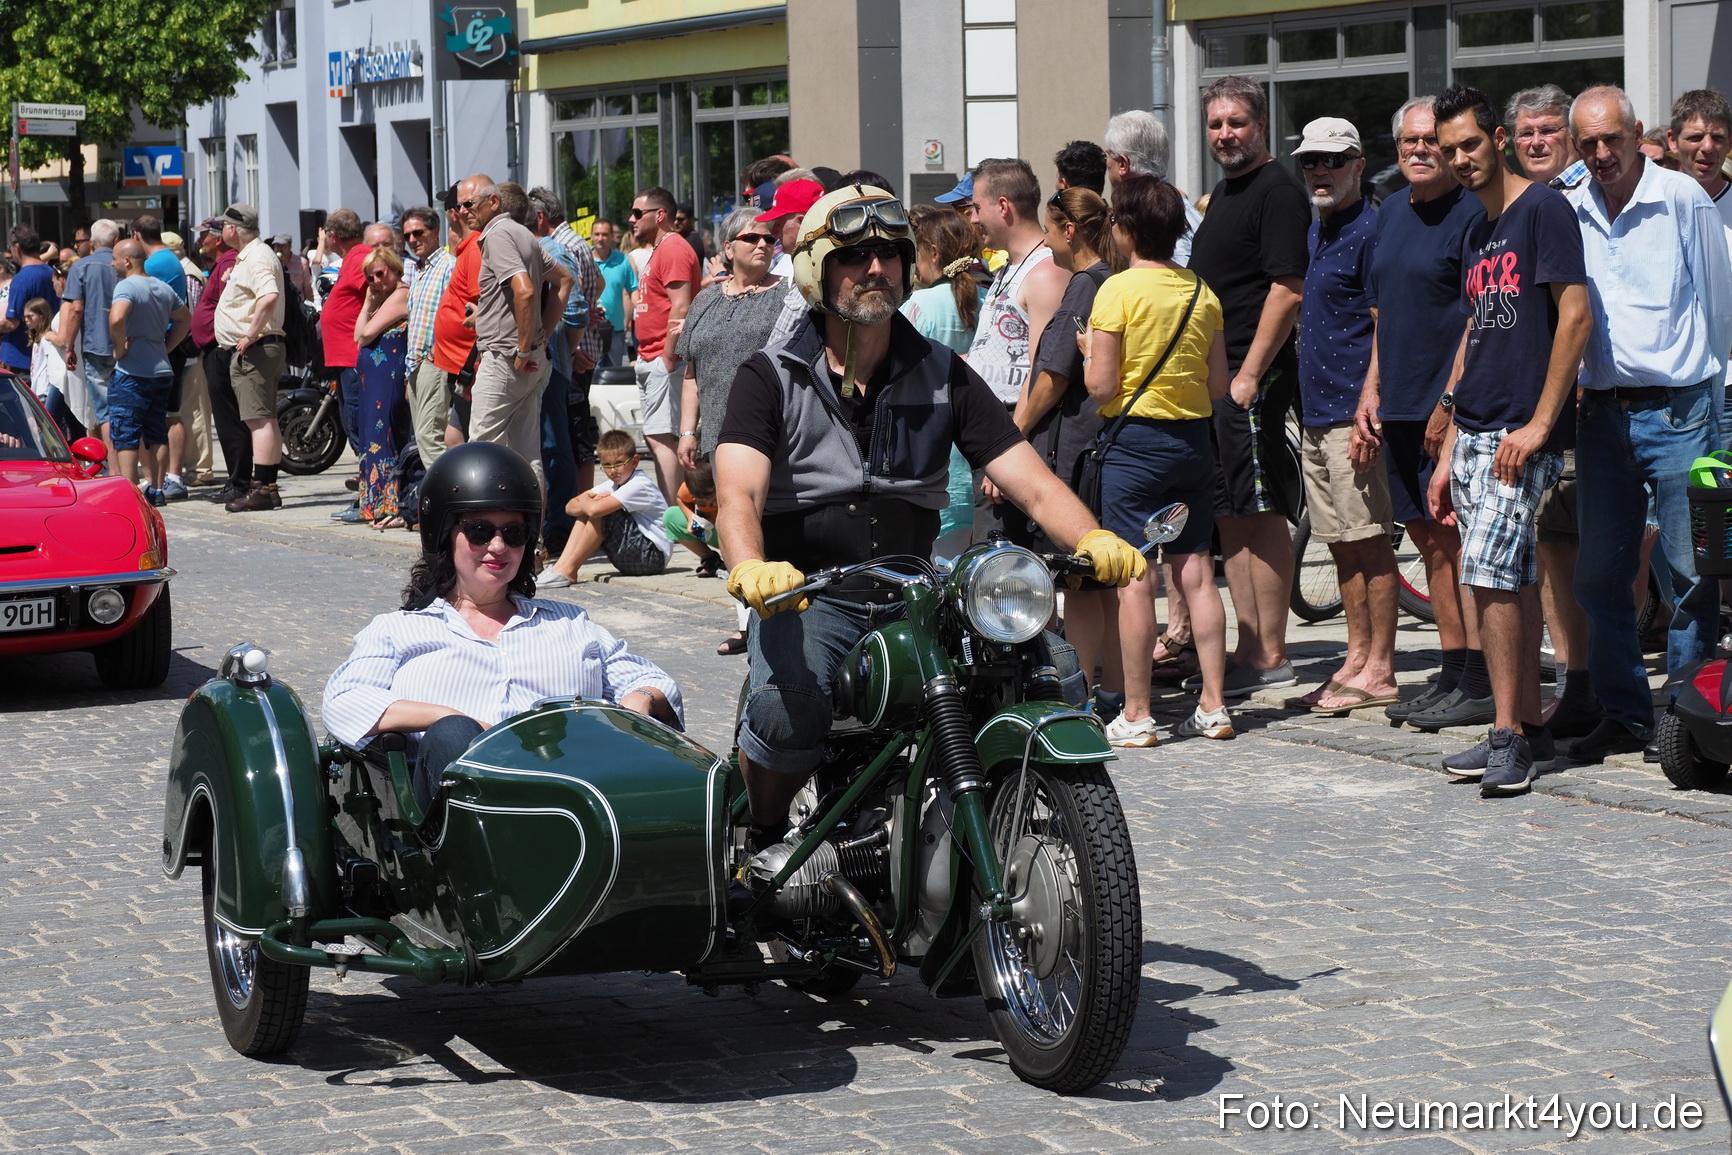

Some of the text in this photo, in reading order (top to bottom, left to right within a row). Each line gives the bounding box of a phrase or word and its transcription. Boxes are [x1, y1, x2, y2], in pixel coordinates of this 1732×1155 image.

[466, 18, 494, 53] G2
[20, 104, 84, 118] Brunnwirtsgasse
[1470, 284, 1519, 330] NES
[4, 602, 52, 627] 90H
